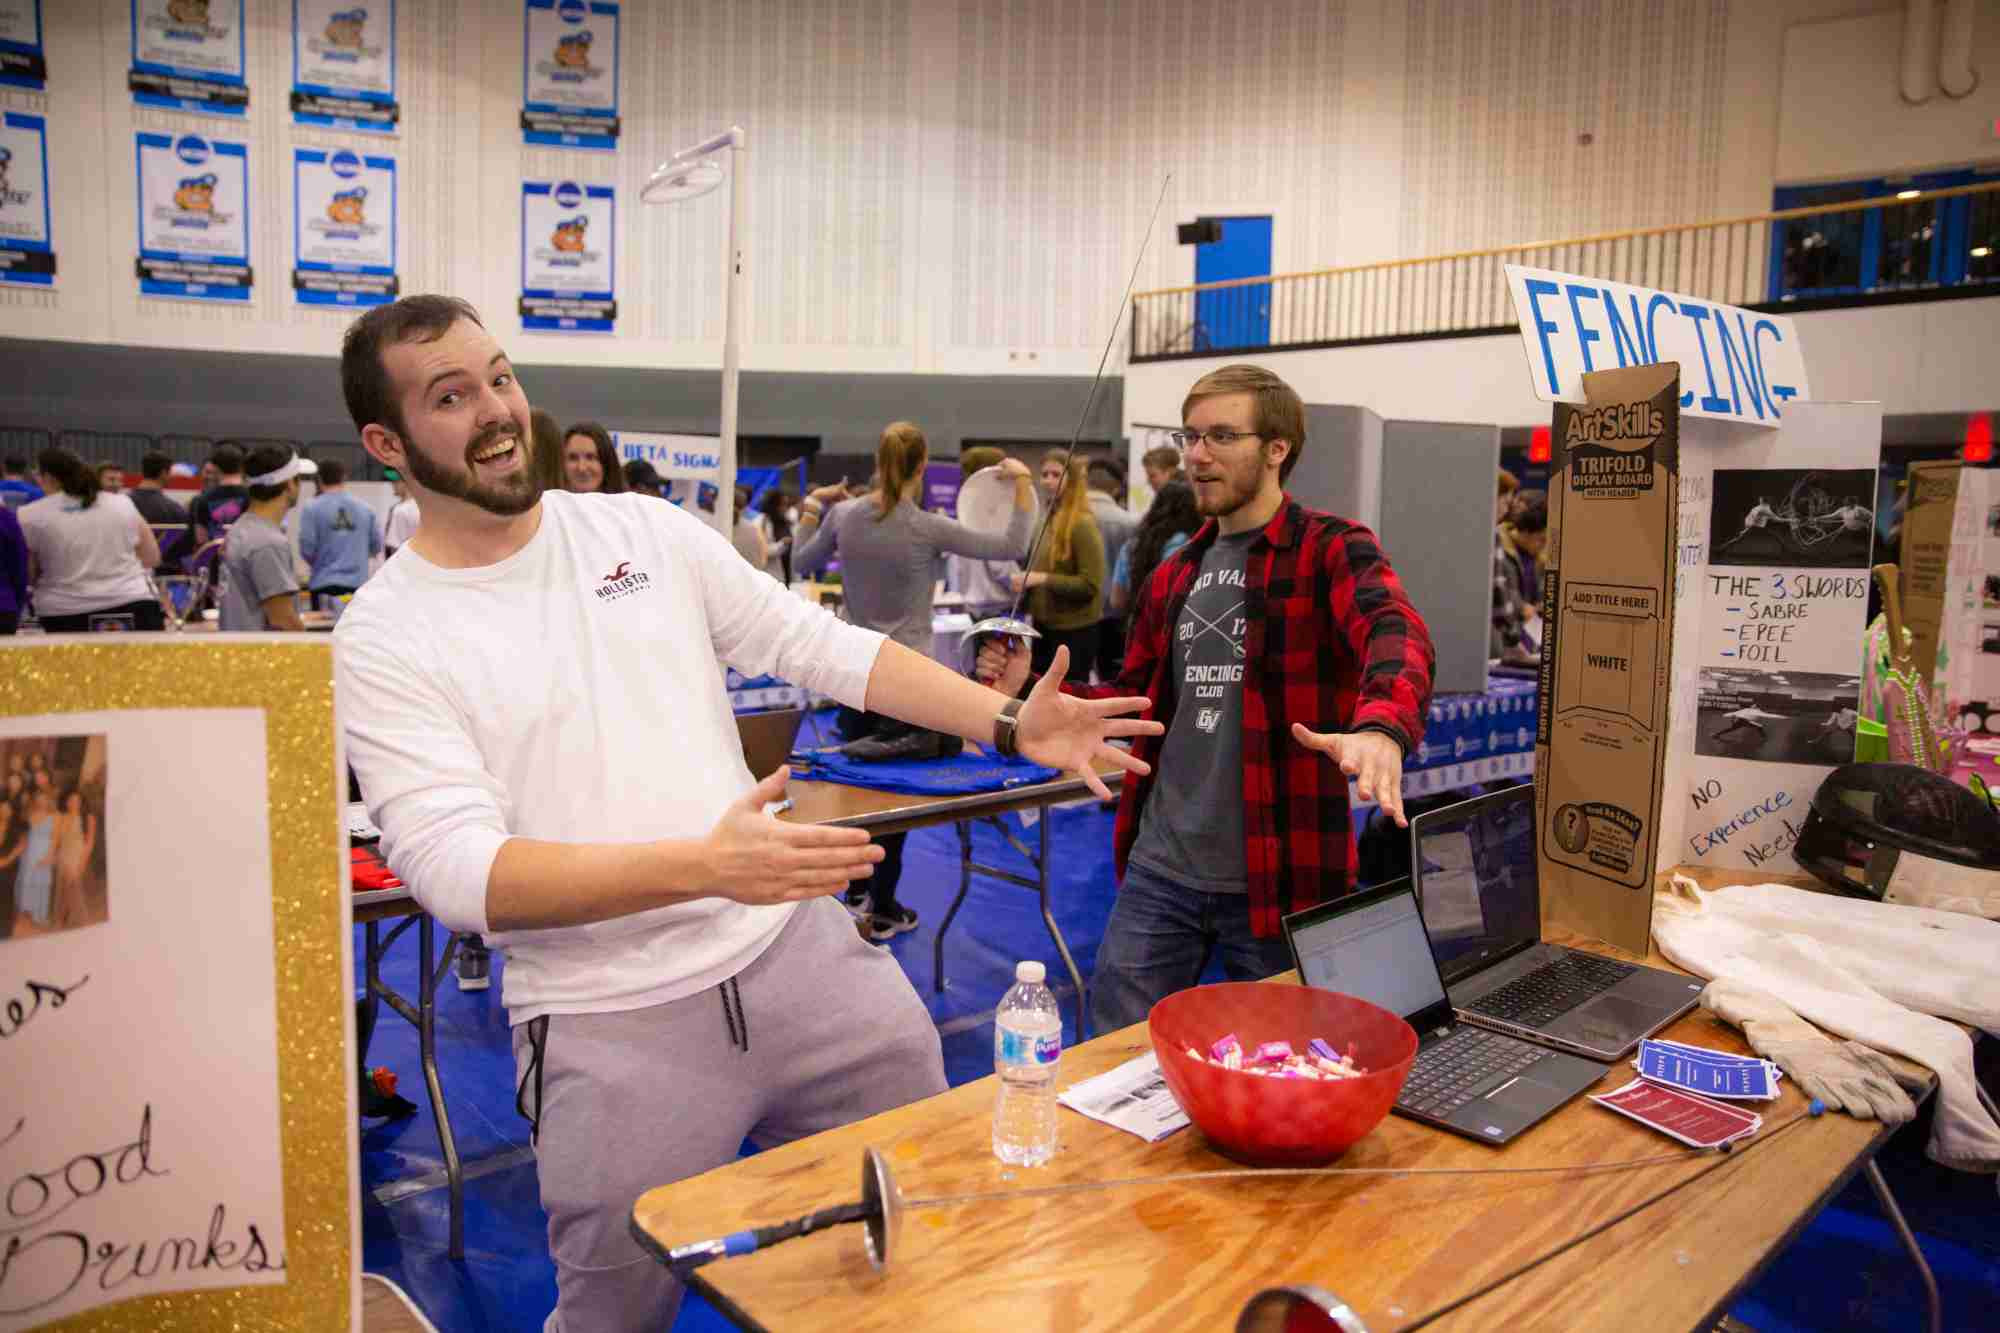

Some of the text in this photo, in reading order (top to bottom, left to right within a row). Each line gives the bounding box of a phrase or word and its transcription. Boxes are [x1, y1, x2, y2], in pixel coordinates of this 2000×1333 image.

[1525, 279, 1798, 419] FENCING
[1566, 401, 1664, 441] ArtSkills
[1580, 455, 1645, 474] TRIFOLD
[1573, 474, 1652, 486] DISPLAY BOARD
[594, 572, 650, 598] HOLLISTER
[1708, 574, 1761, 597] THE
[1771, 573, 1786, 599] 3
[1791, 574, 1866, 599] SWORDS
[1572, 592, 1592, 604] ADD
[1594, 594, 1619, 607] TITLE
[1179, 622, 1194, 640] 20
[1185, 665, 1244, 683] ENCING
[1587, 653, 1629, 672] WHITE
[1196, 685, 1223, 698] CLUB
[1691, 779, 1722, 810] NO
[1690, 791, 1793, 857] Experience
[1742, 819, 1805, 868] Need
[0, 1103, 170, 1222] ood
